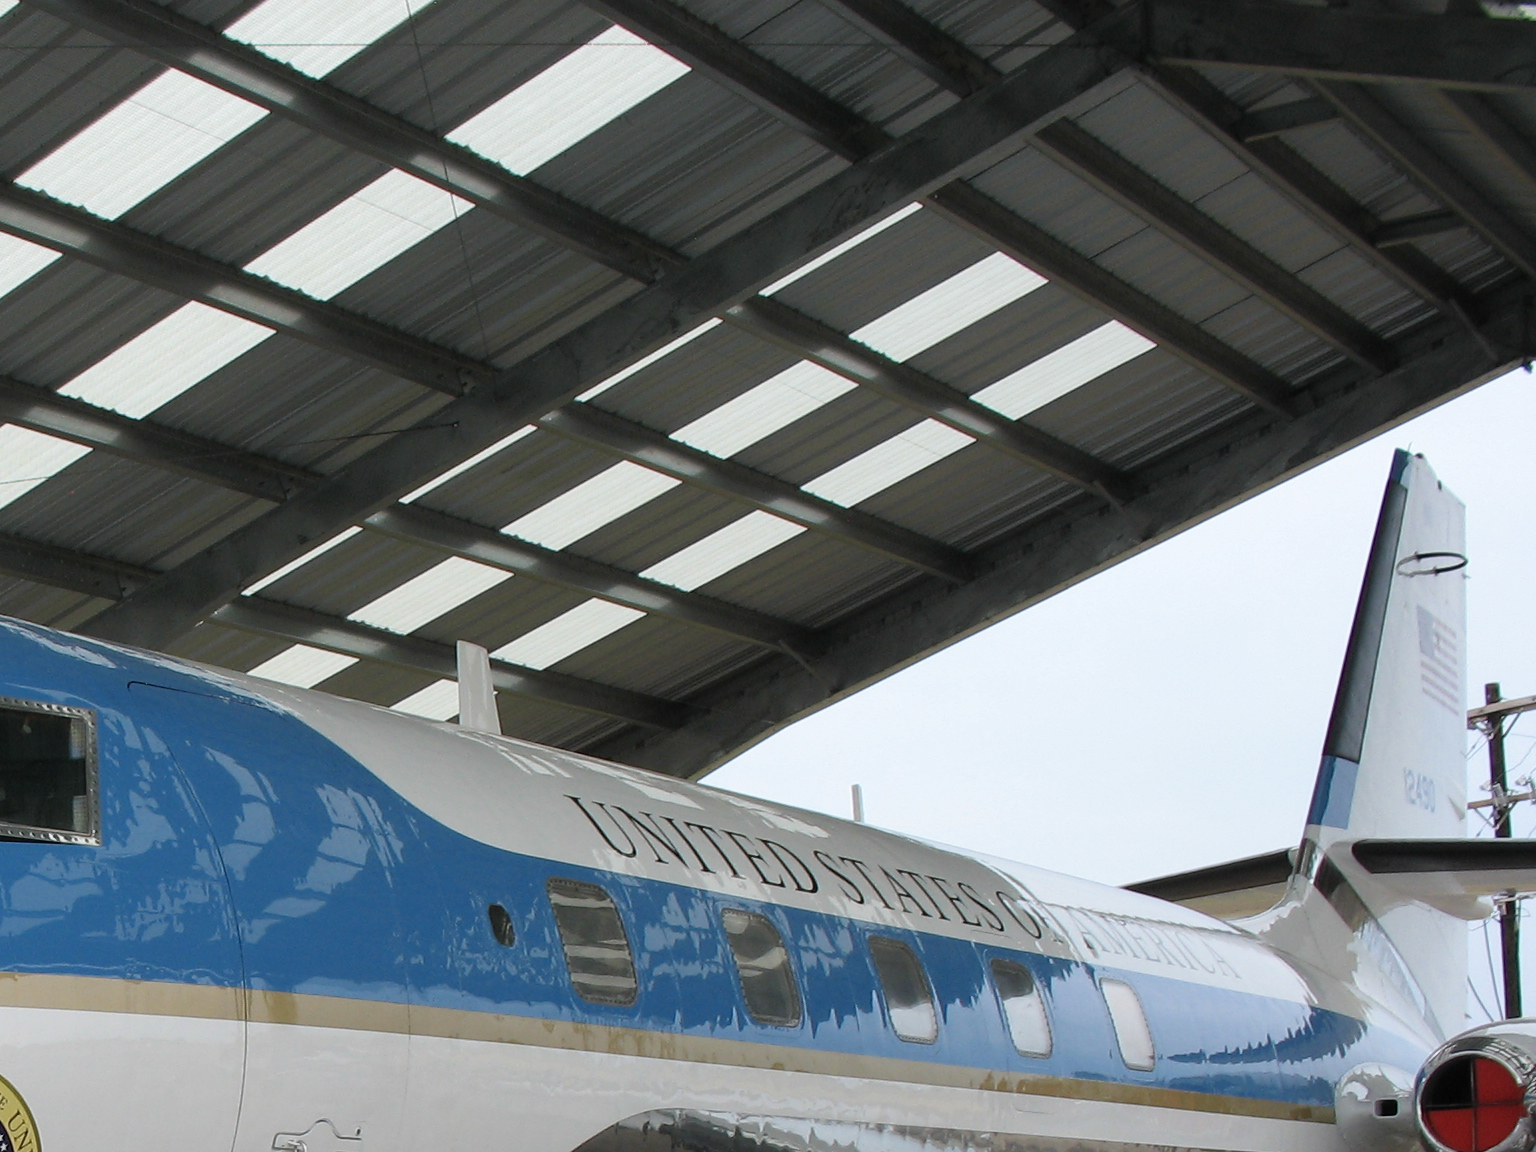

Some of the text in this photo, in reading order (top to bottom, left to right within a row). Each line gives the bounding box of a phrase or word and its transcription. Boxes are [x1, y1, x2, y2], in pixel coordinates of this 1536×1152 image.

[562, 793, 819, 894] UNITED
[813, 849, 1005, 932] STATES
[1066, 905, 1243, 979] AMERICA
